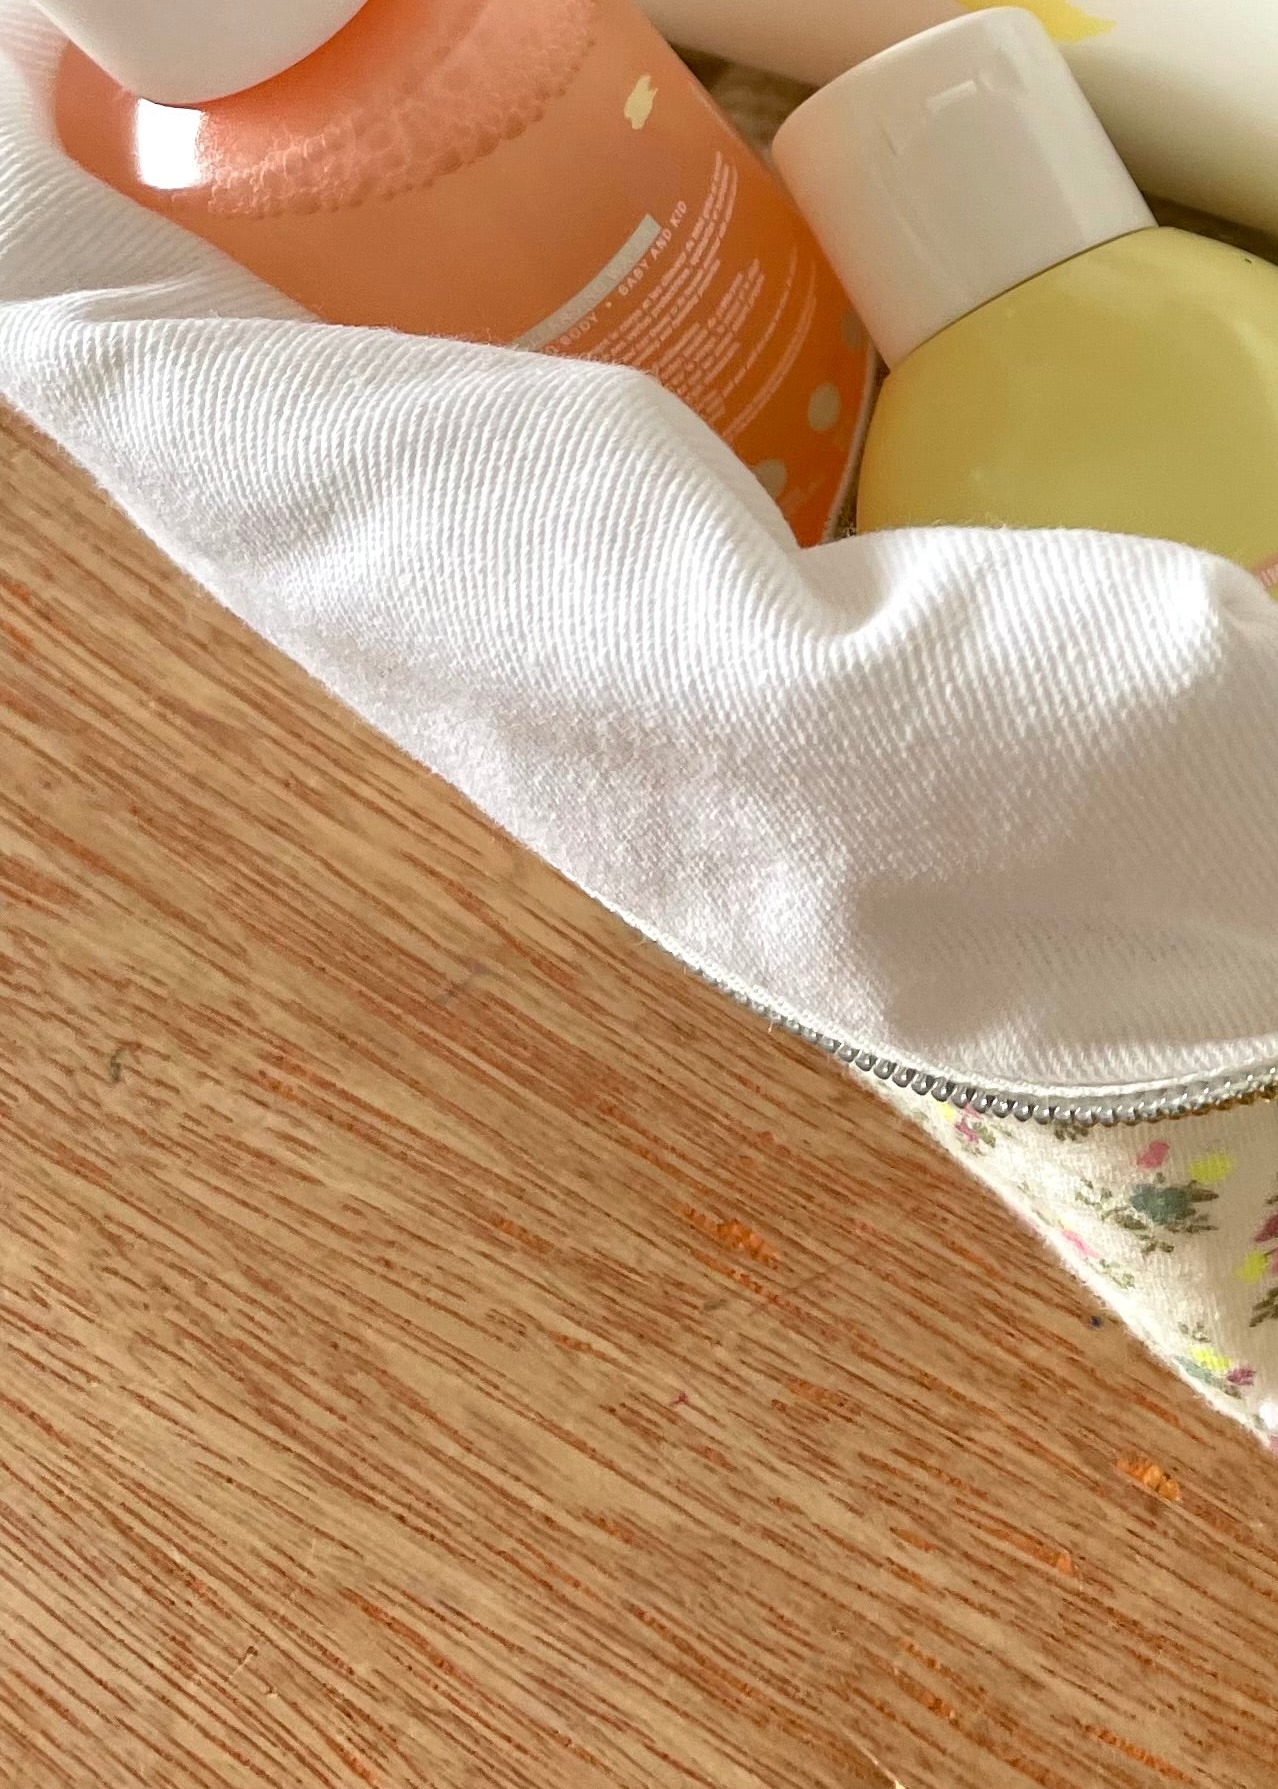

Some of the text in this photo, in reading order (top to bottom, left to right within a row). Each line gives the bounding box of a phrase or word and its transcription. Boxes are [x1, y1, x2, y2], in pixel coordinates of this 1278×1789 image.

[618, 259, 650, 296] BABY
[650, 229, 672, 260] AND
[670, 201, 687, 228] KID
